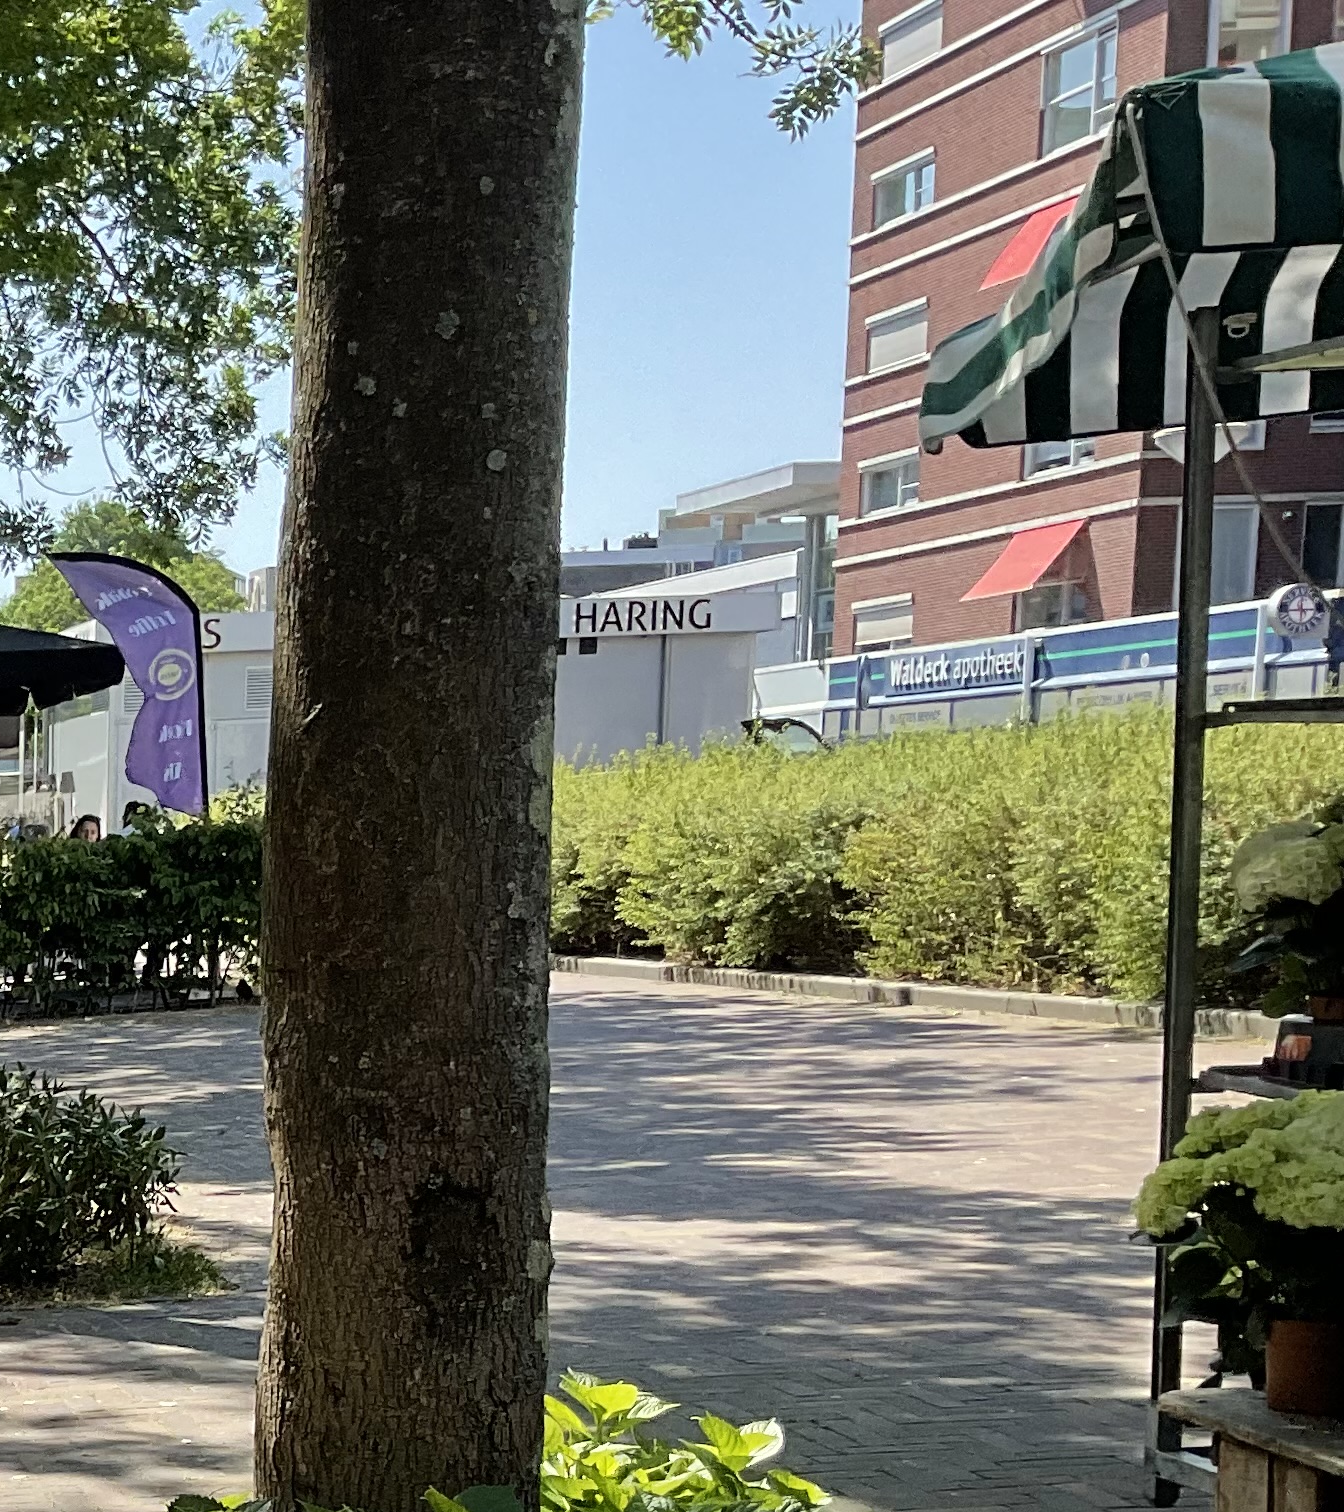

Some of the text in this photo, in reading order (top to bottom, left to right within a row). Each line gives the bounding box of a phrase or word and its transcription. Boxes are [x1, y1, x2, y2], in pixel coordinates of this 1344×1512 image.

[575, 600, 711, 633] HARING
[890, 645, 1024, 686] Waldeck apotheek
